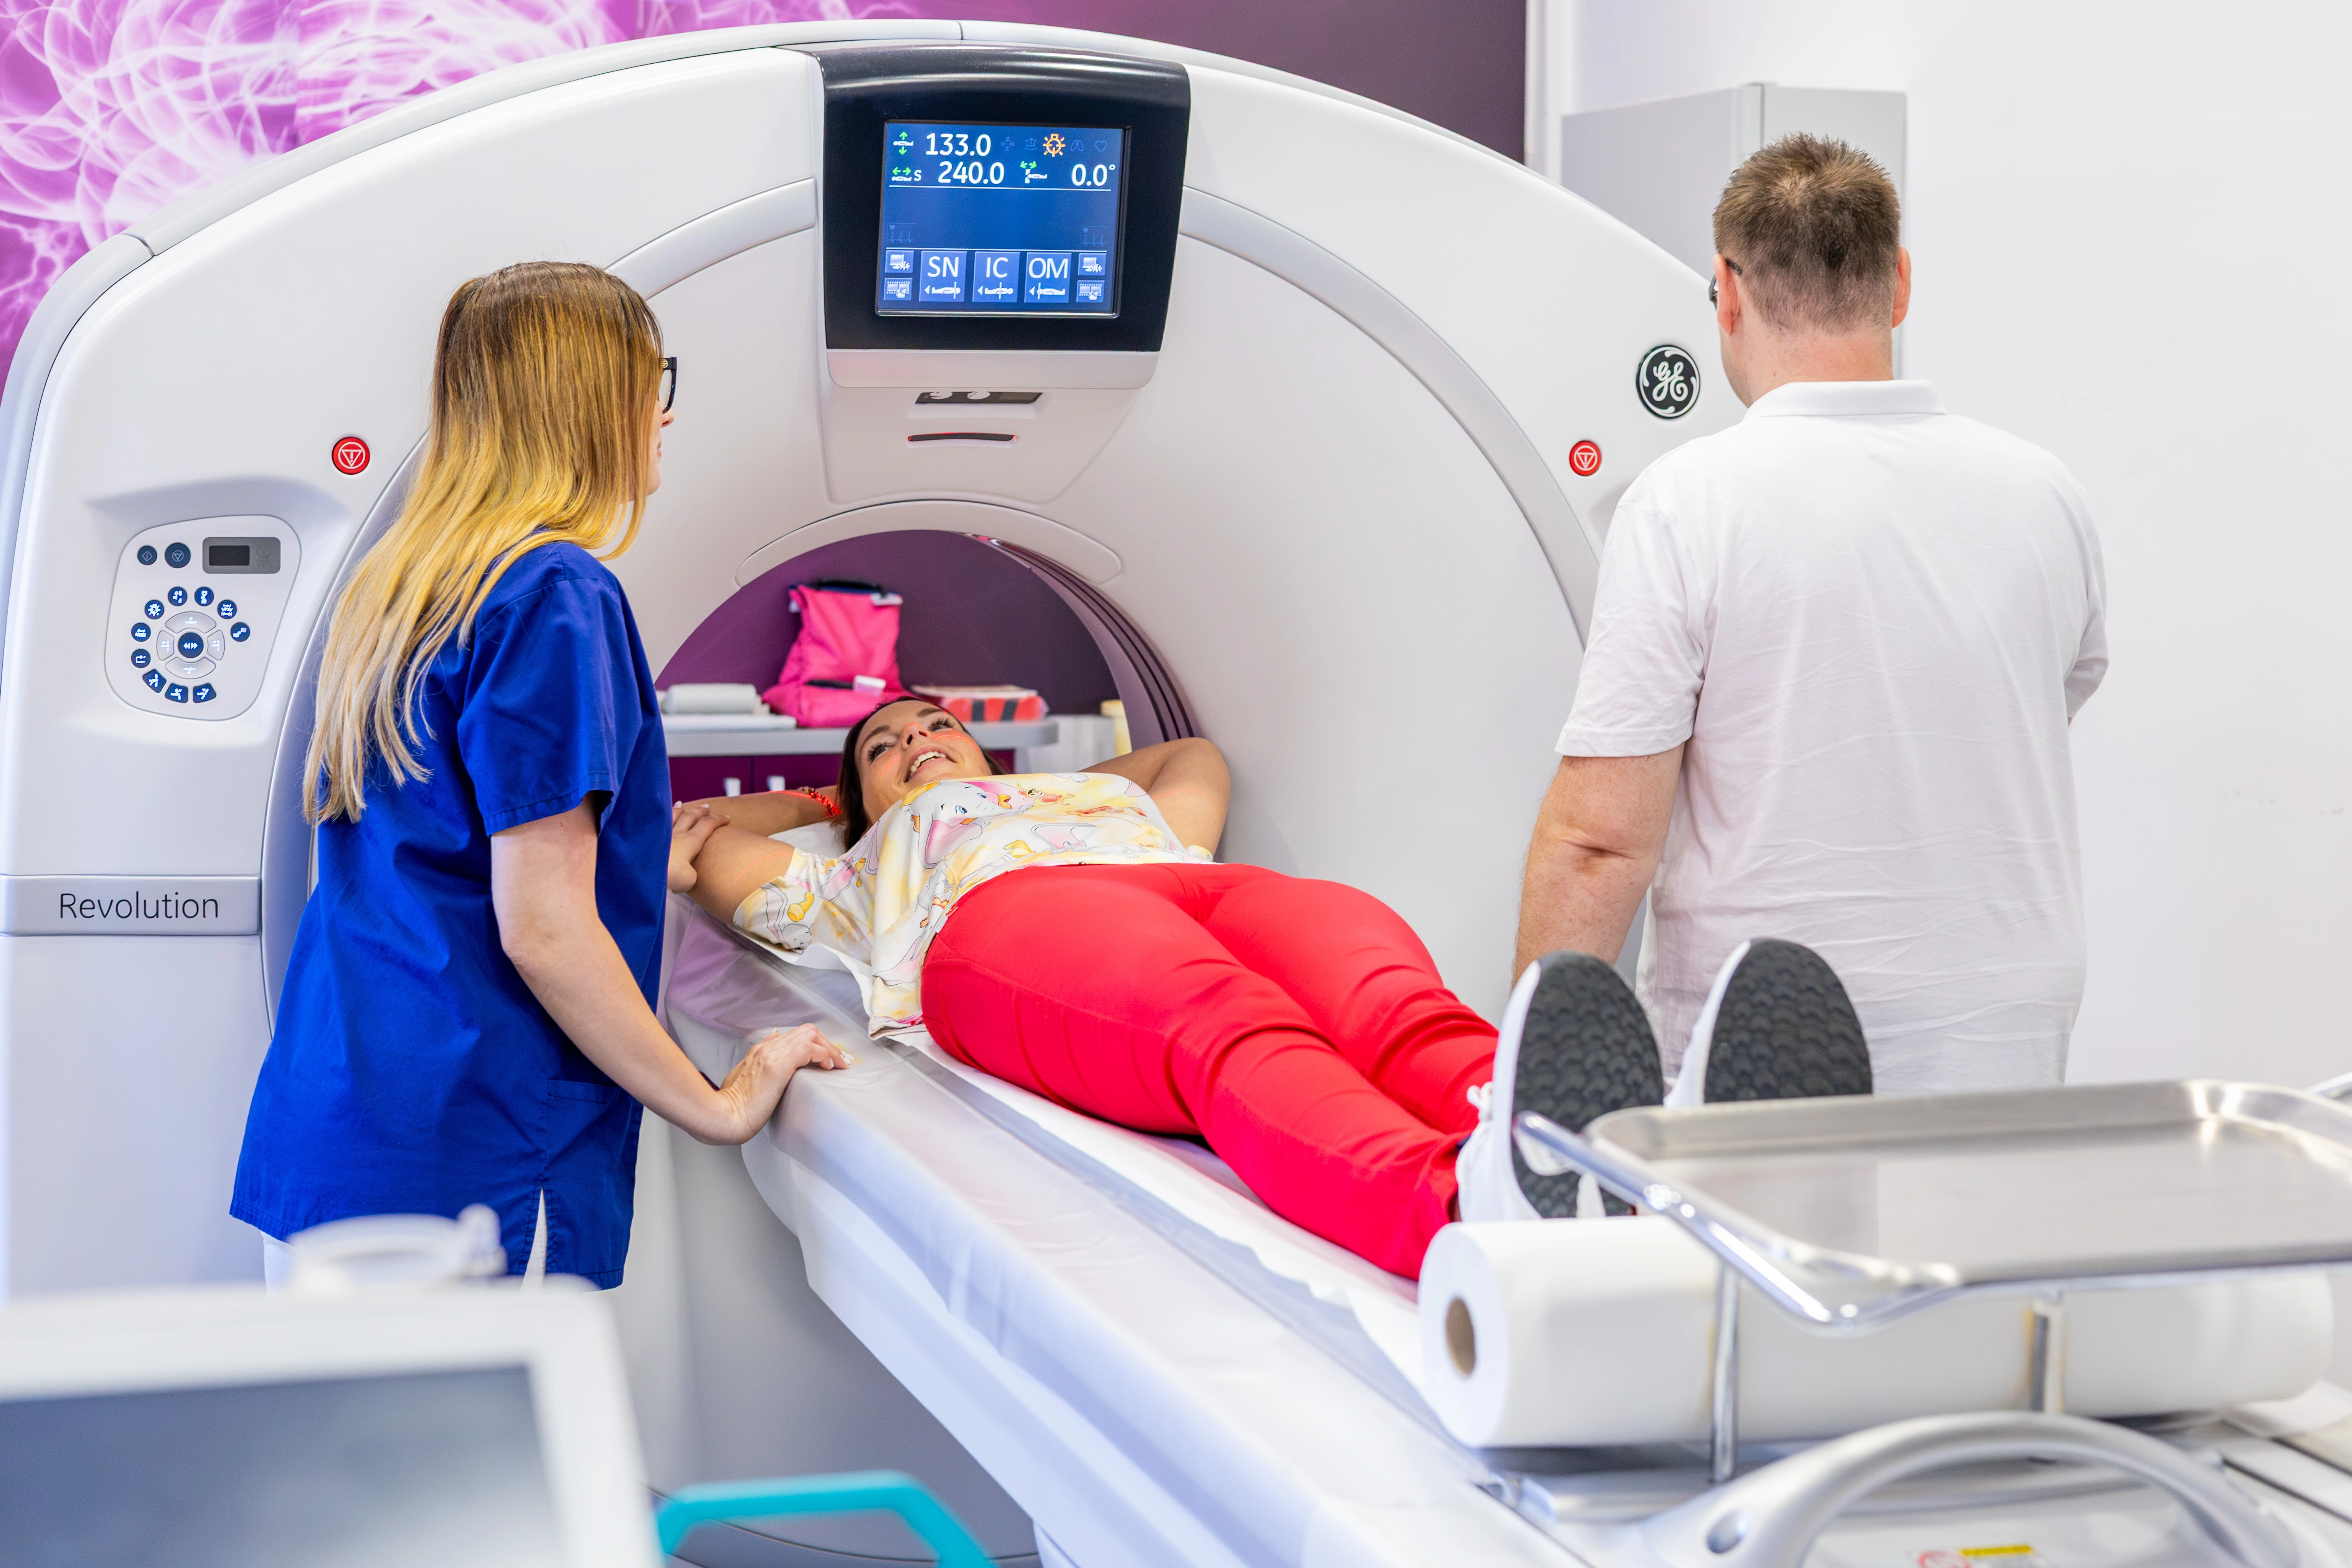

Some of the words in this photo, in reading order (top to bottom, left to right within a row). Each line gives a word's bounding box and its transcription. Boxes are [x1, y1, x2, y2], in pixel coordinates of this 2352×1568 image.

[925, 133, 991, 156] 133.0
[937, 161, 1005, 184] 240.0
[1071, 163, 1116, 187] 0.0°
[927, 256, 959, 277] SN
[986, 257, 1008, 278] IC
[1028, 257, 1069, 279] OM
[1652, 361, 1688, 401] GE
[60, 891, 219, 919] Revolution
